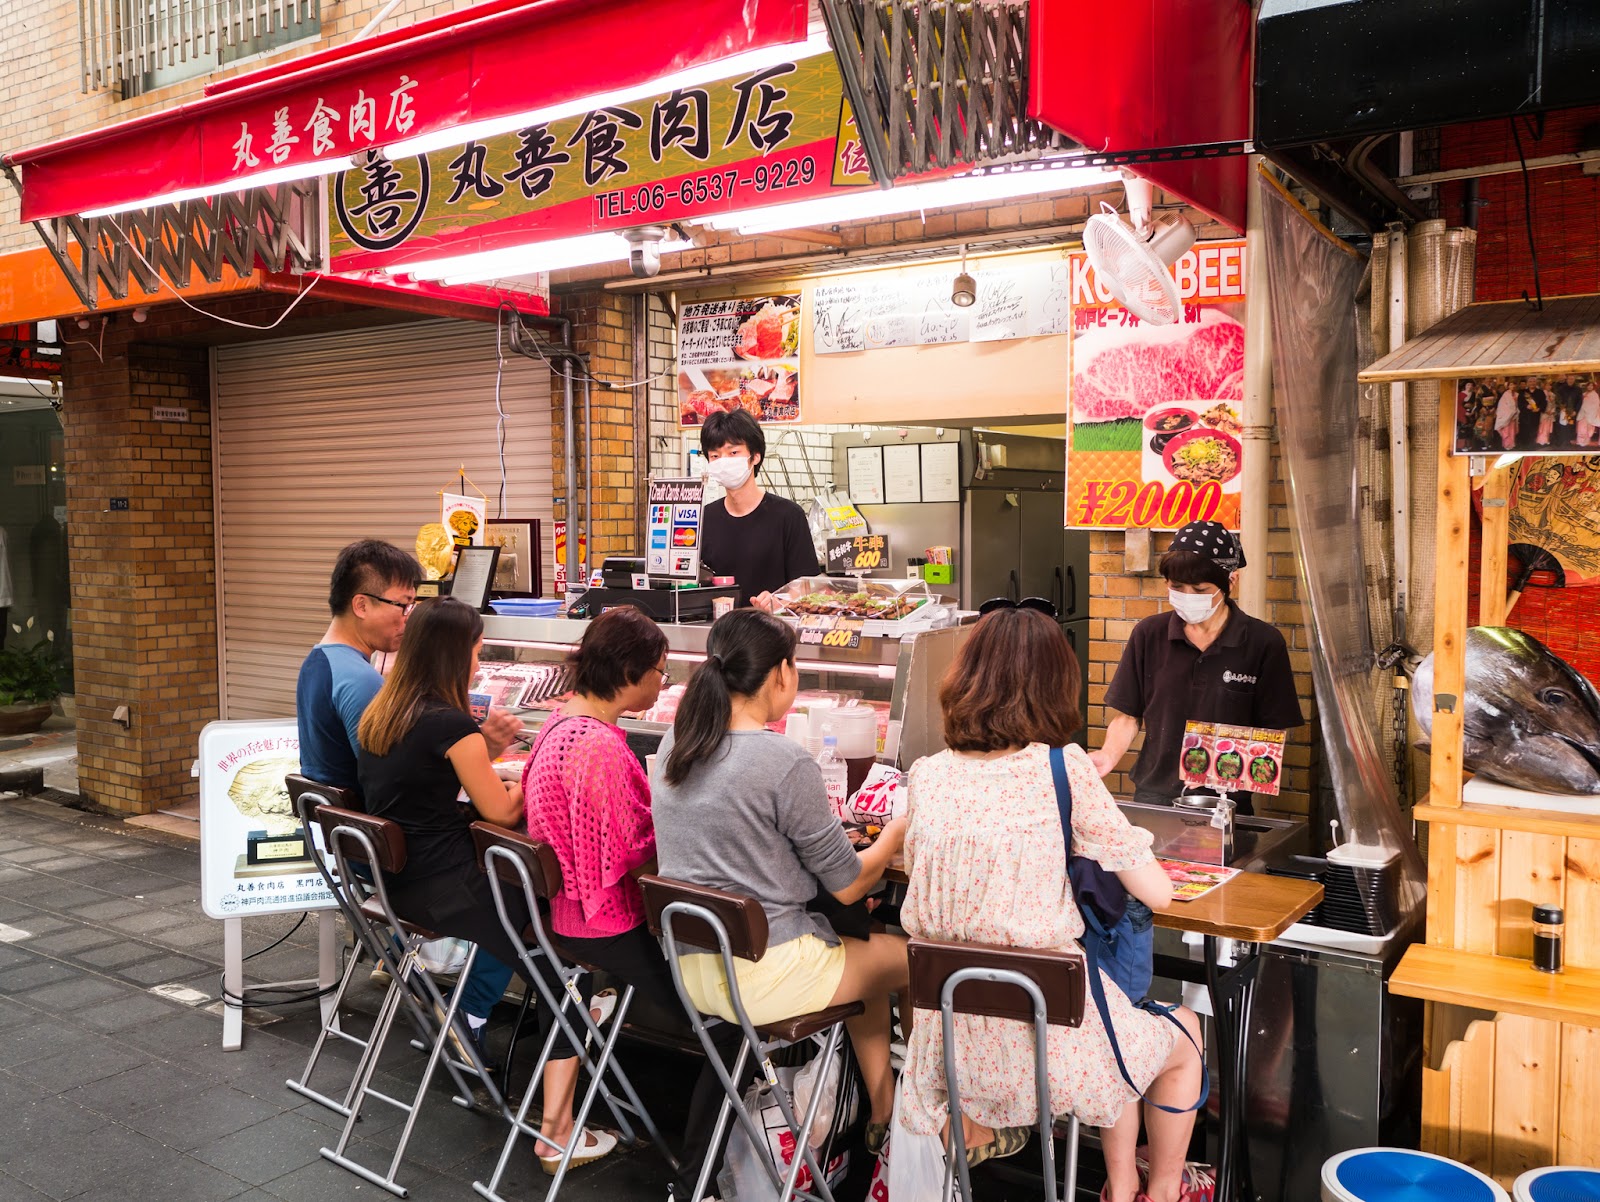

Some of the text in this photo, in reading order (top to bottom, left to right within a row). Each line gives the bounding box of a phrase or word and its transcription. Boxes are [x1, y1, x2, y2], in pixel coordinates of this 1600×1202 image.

[232, 75, 418, 171] 丸善食肉店
[446, 62, 797, 203] 丸善食肉店
[595, 156, 815, 219] TEL:06-6537-9229
[1174, 247, 1246, 299] BEE
[651, 484, 702, 503] Credit Cards Accepted
[1077, 480, 1222, 527] ¥2000
[652, 506, 670, 523] JCB
[678, 509, 697, 519] VISA
[853, 535, 885, 552] 牛串
[237, 878, 323, 892] 丸善食肉店 黒門店
